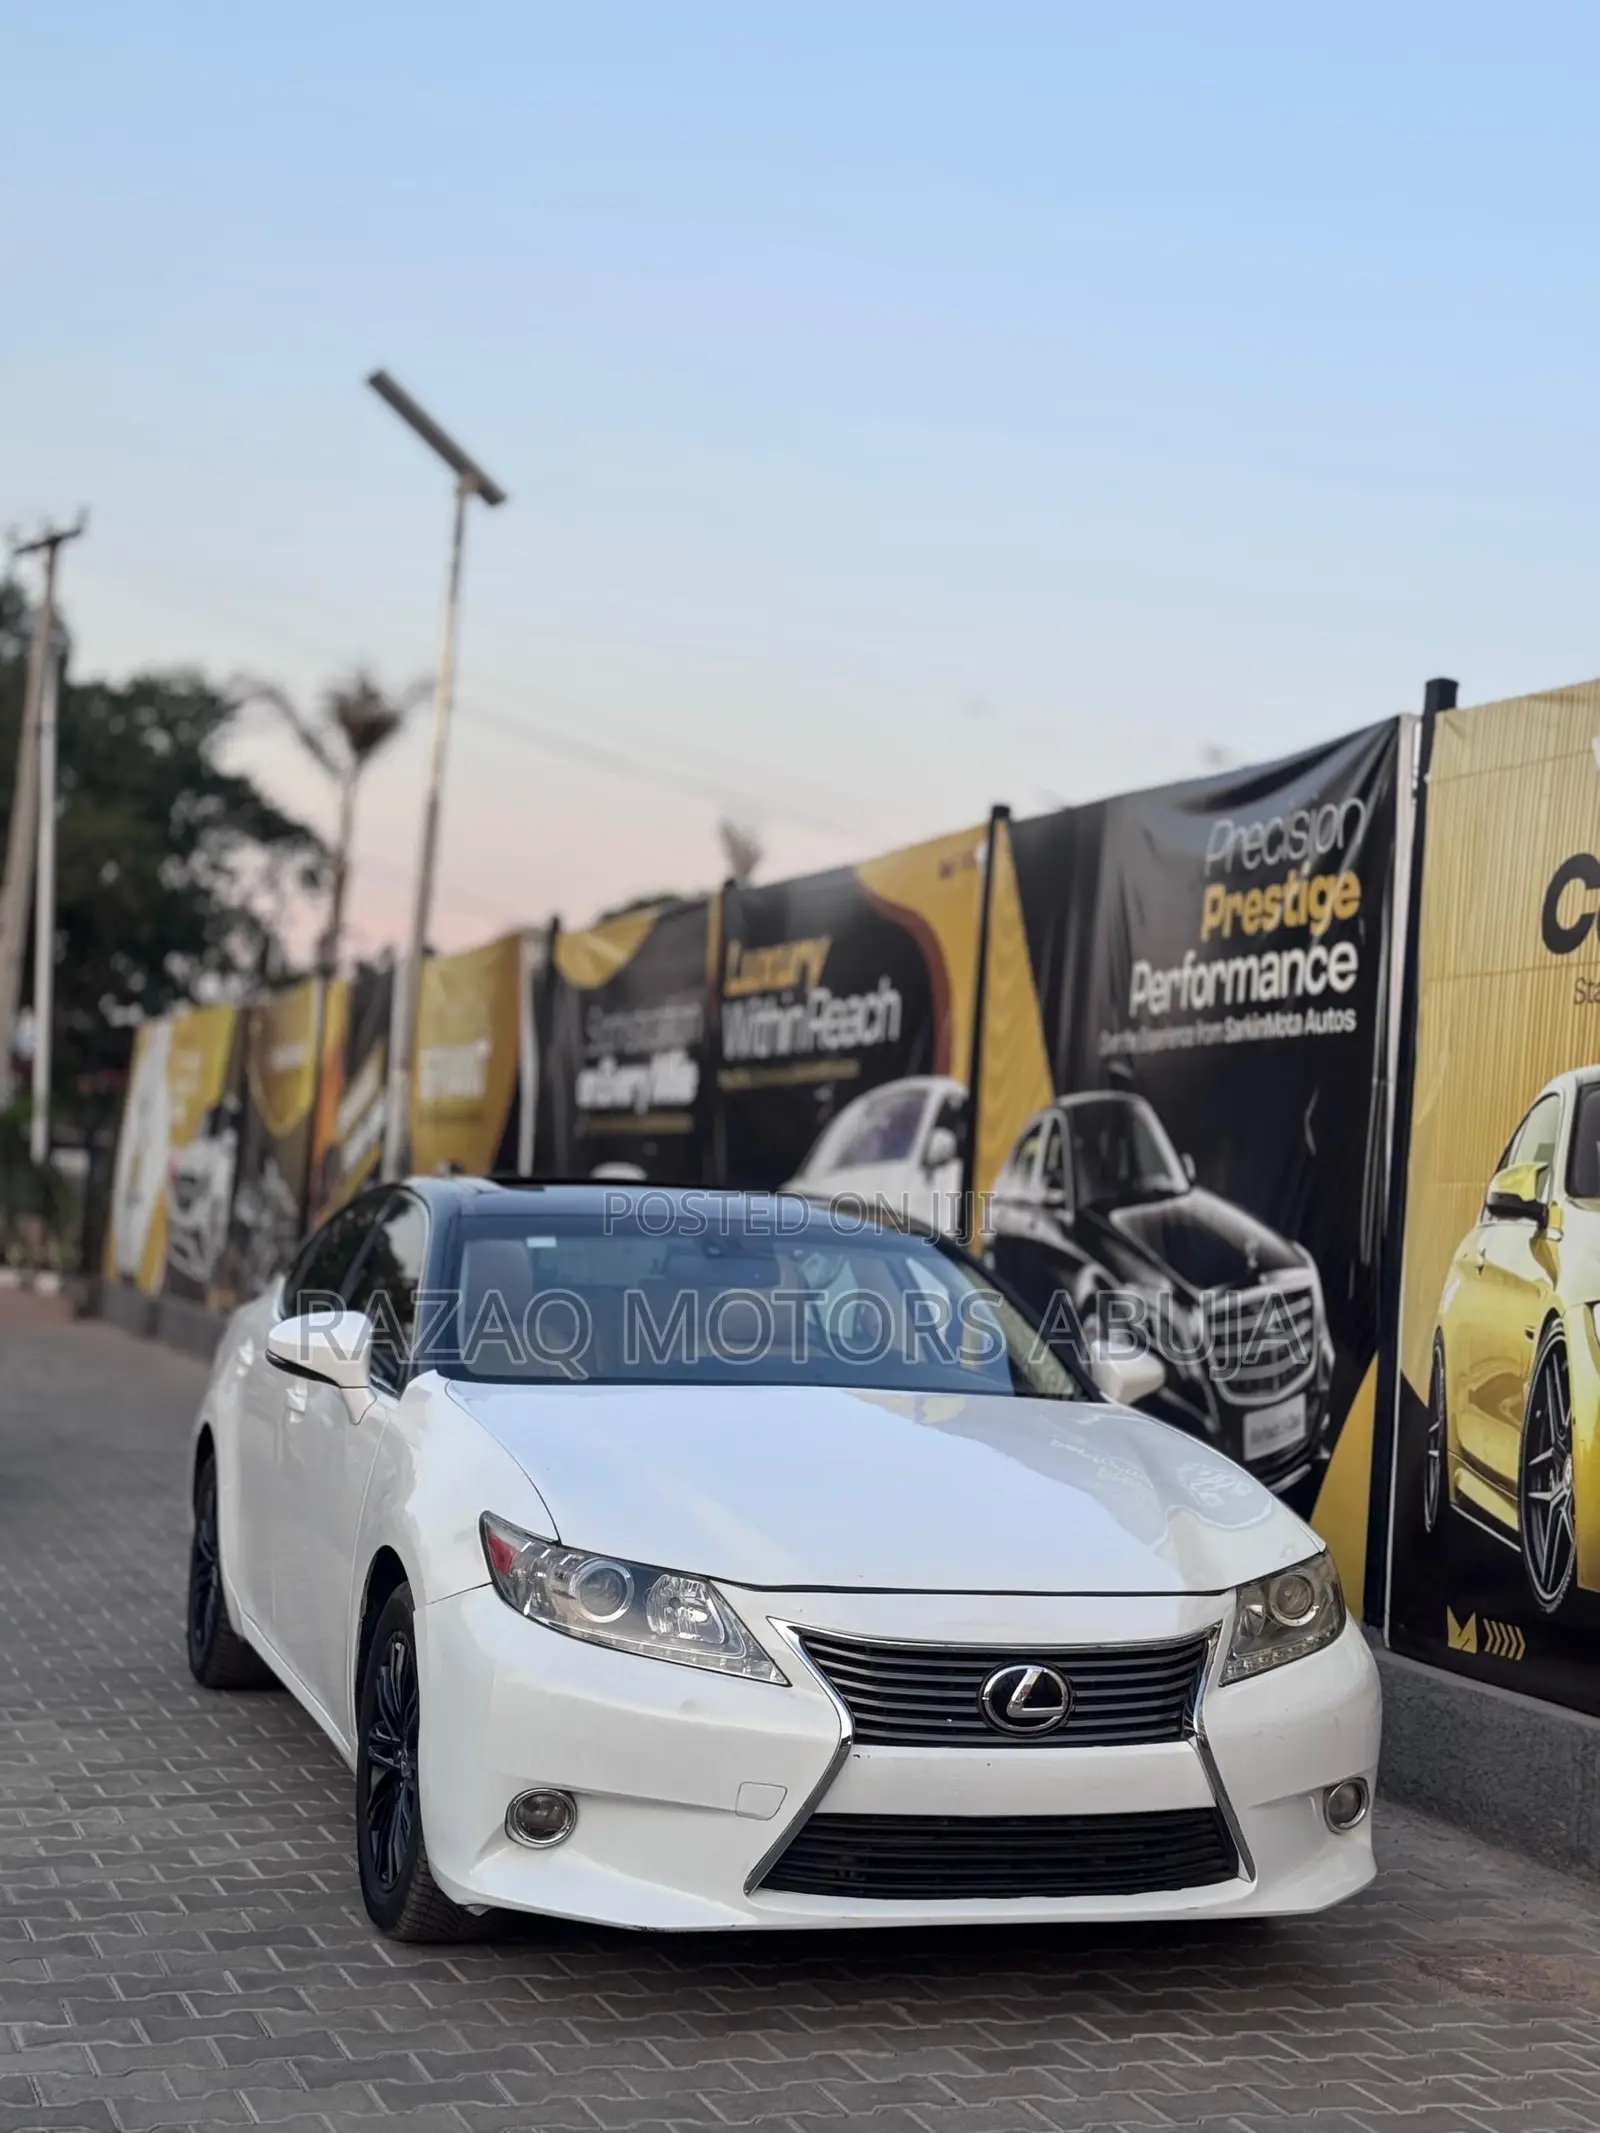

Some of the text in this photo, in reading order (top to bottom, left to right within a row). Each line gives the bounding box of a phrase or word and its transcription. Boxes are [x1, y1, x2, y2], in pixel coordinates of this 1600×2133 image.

[1204, 798, 1366, 877] Precision
[1200, 867, 1362, 943] Prestige
[1541, 853, 1600, 955] C
[1128, 941, 1359, 1018] Performance
[1304, 1006, 1357, 1036] Autos
